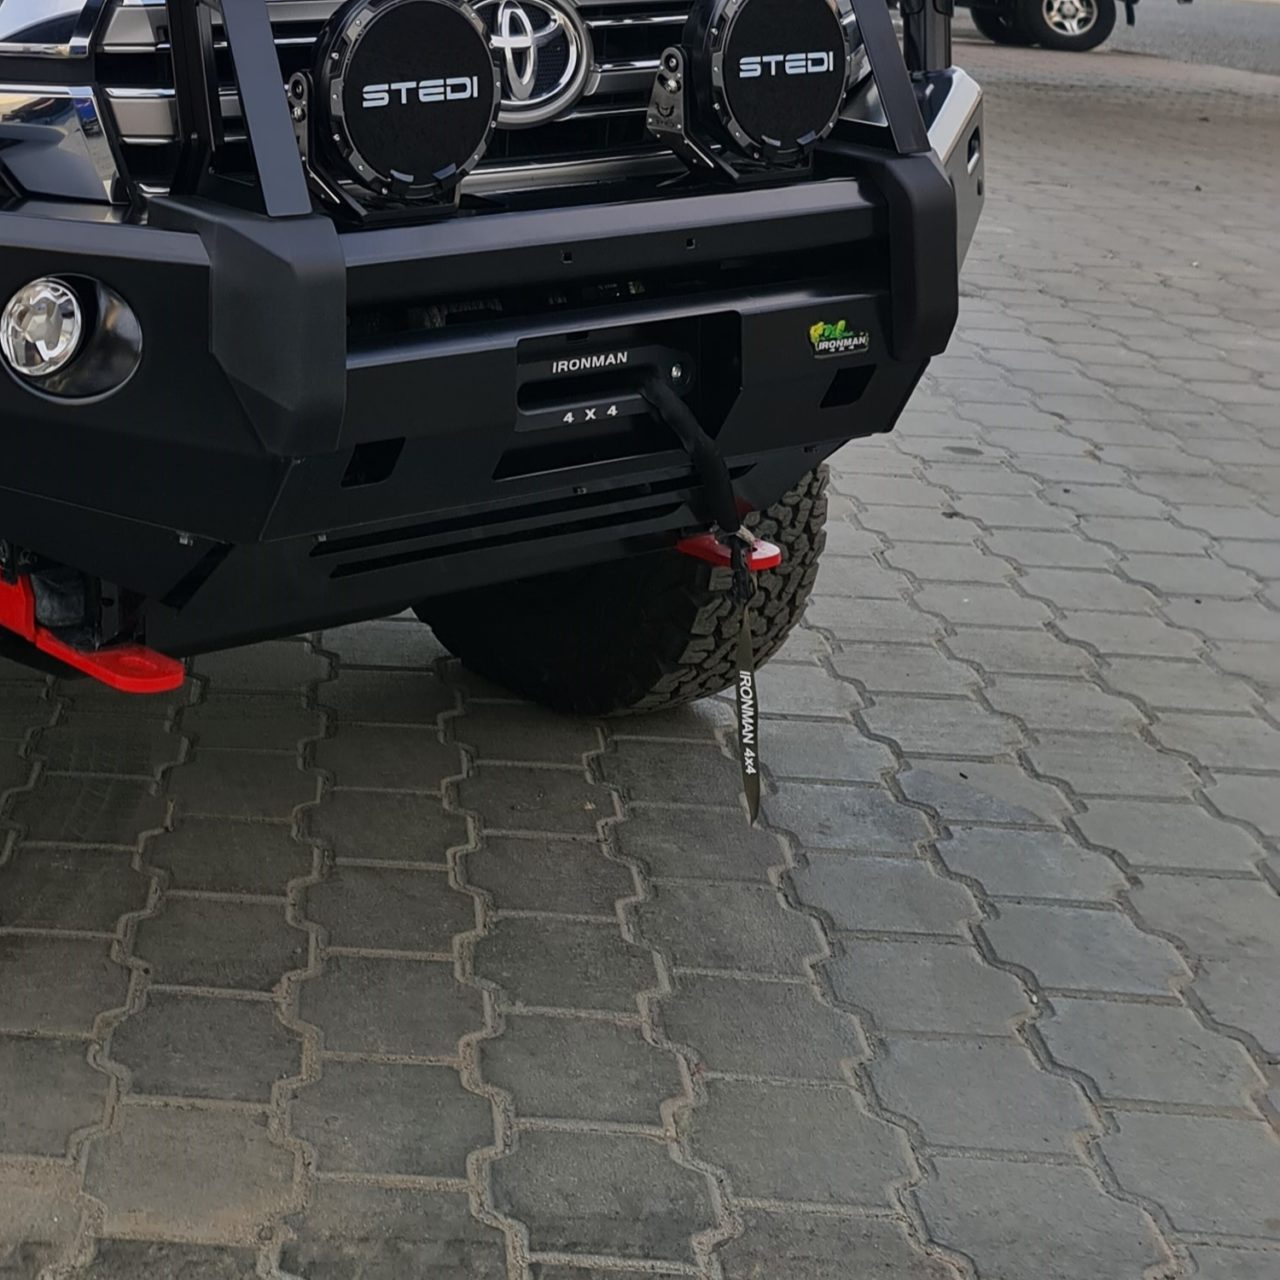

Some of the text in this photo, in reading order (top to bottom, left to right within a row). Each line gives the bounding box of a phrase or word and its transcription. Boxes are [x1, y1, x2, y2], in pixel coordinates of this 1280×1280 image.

[739, 51, 834, 78] STEDI
[362, 76, 479, 108] STEDI
[818, 336, 866, 350] IRONMAN
[552, 351, 628, 373] IRONMAN
[739, 670, 757, 775] IRONMAN 4x4
